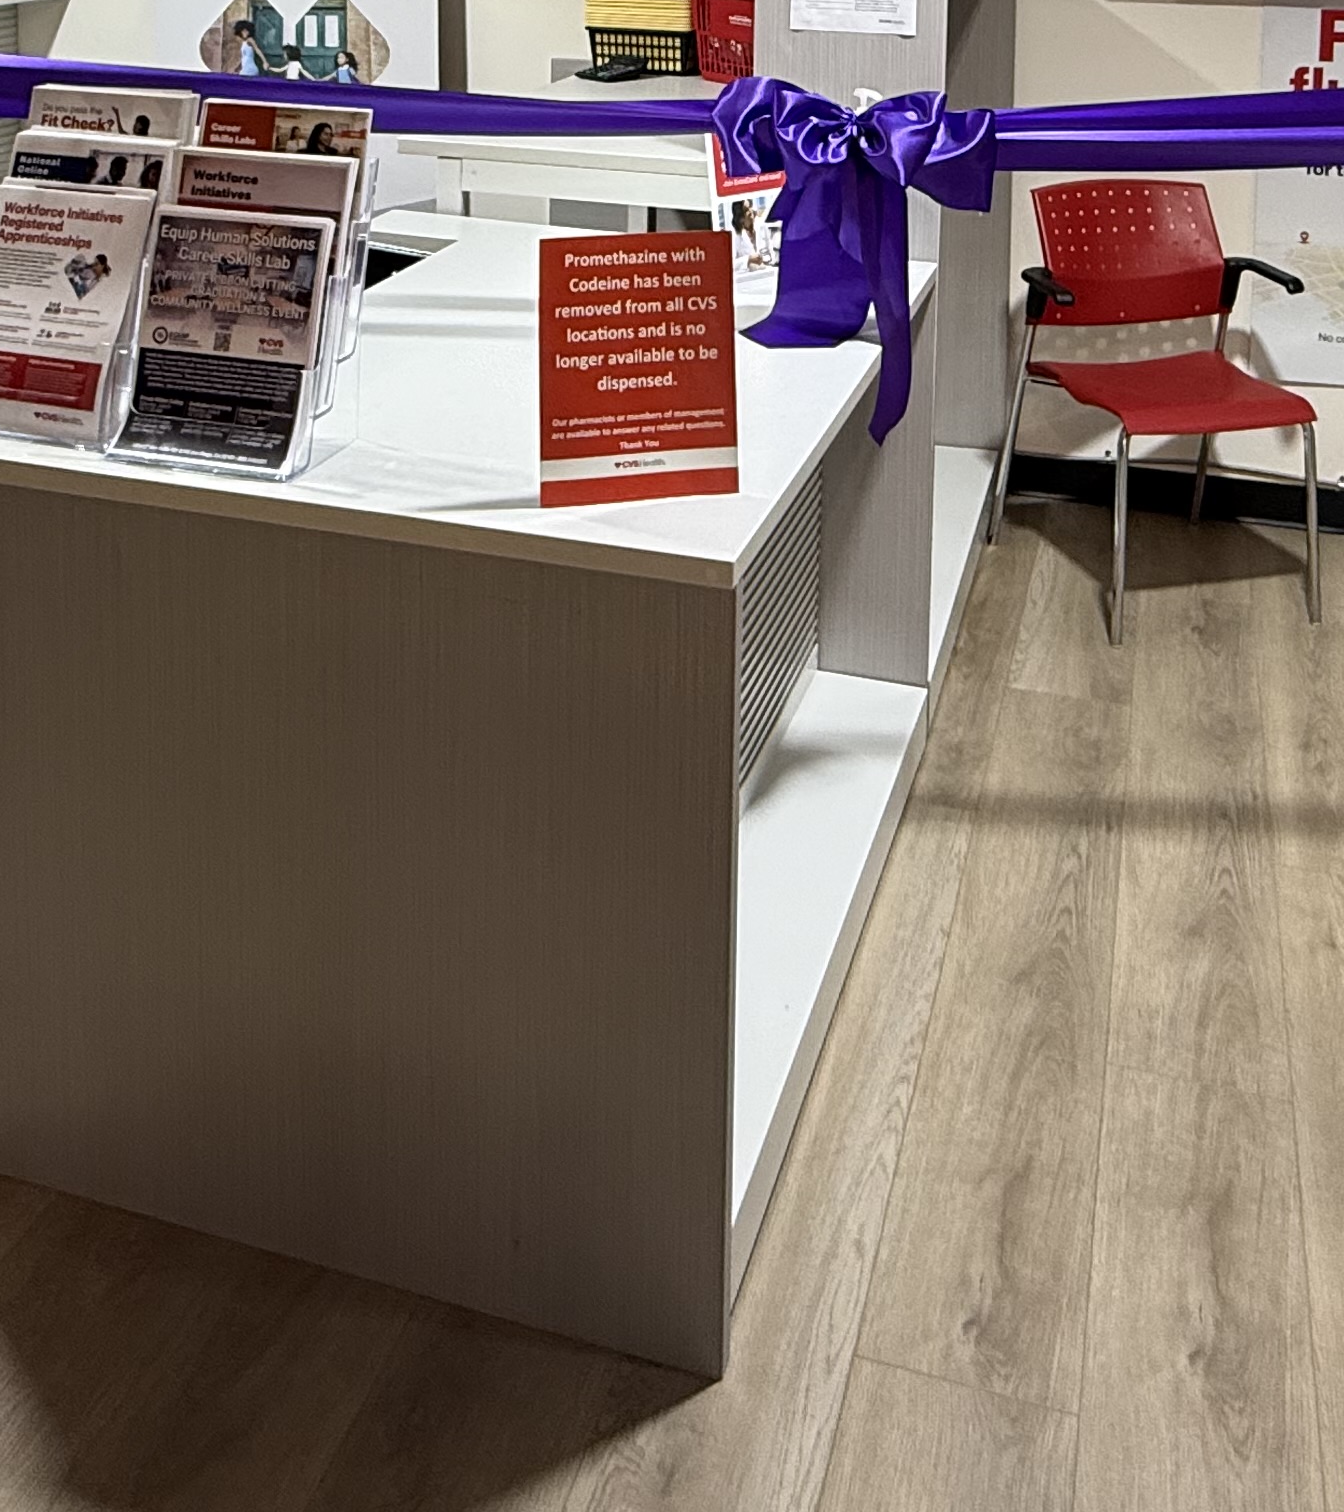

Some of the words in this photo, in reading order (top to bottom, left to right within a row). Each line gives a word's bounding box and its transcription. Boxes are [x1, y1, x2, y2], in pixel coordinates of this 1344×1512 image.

[41, 114, 58, 127] Fit
[61, 115, 115, 132] Check?
[211, 123, 241, 133] Career
[210, 134, 234, 144] Skills
[235, 136, 256, 145] Labs
[19, 155, 60, 166] National
[194, 169, 258, 185] Workforce
[191, 186, 251, 200] Initiatives
[5, 202, 65, 218] Workforce
[67, 208, 123, 224] Initiatives
[1, 216, 64, 232] Registered
[161, 224, 197, 242] Equip
[201, 228, 249, 245] Human
[254, 234, 315, 251] Solutions
[179, 247, 222, 264] Career
[227, 252, 262, 266] Skills
[266, 255, 291, 269] Lab
[565, 249, 667, 268] Promethazine
[672, 247, 705, 263] with
[165, 270, 209, 283] PRIVATE
[251, 278, 297, 291] CUTTING
[569, 276, 629, 293] Codeine
[634, 274, 659, 288] has
[663, 273, 701, 287] been
[193, 286, 256, 302] GRADUATION
[151, 294, 215, 310] COMMUNITY
[216, 301, 269, 316] WELLNESS
[272, 308, 305, 320] EVENT
[555, 299, 621, 318] removed
[625, 299, 661, 314] from
[665, 297, 683, 312] all
[688, 296, 717, 311] CVS
[567, 326, 634, 342] locations
[638, 322, 666, 338] and
[670, 322, 682, 336] is
[686, 323, 706, 335] no
[1318, 333, 1333, 342] No
[556, 354, 604, 370] longer
[608, 347, 675, 365] available
[678, 347, 694, 361] to
[699, 345, 718, 359] be
[597, 371, 678, 392] dispensed.
[552, 418, 567, 427] Our
[569, 416, 615, 426] pharmacists
[627, 412, 662, 421] members
[664, 410, 672, 418] of
[674, 408, 724, 418] management
[552, 432, 565, 440] are
[566, 428, 601, 439] available
[613, 426, 640, 435] answer
[641, 425, 655, 433] any
[657, 422, 684, 431] related
[686, 420, 726, 430] questions.
[619, 441, 642, 450] Thank
[644, 440, 659, 448] You
